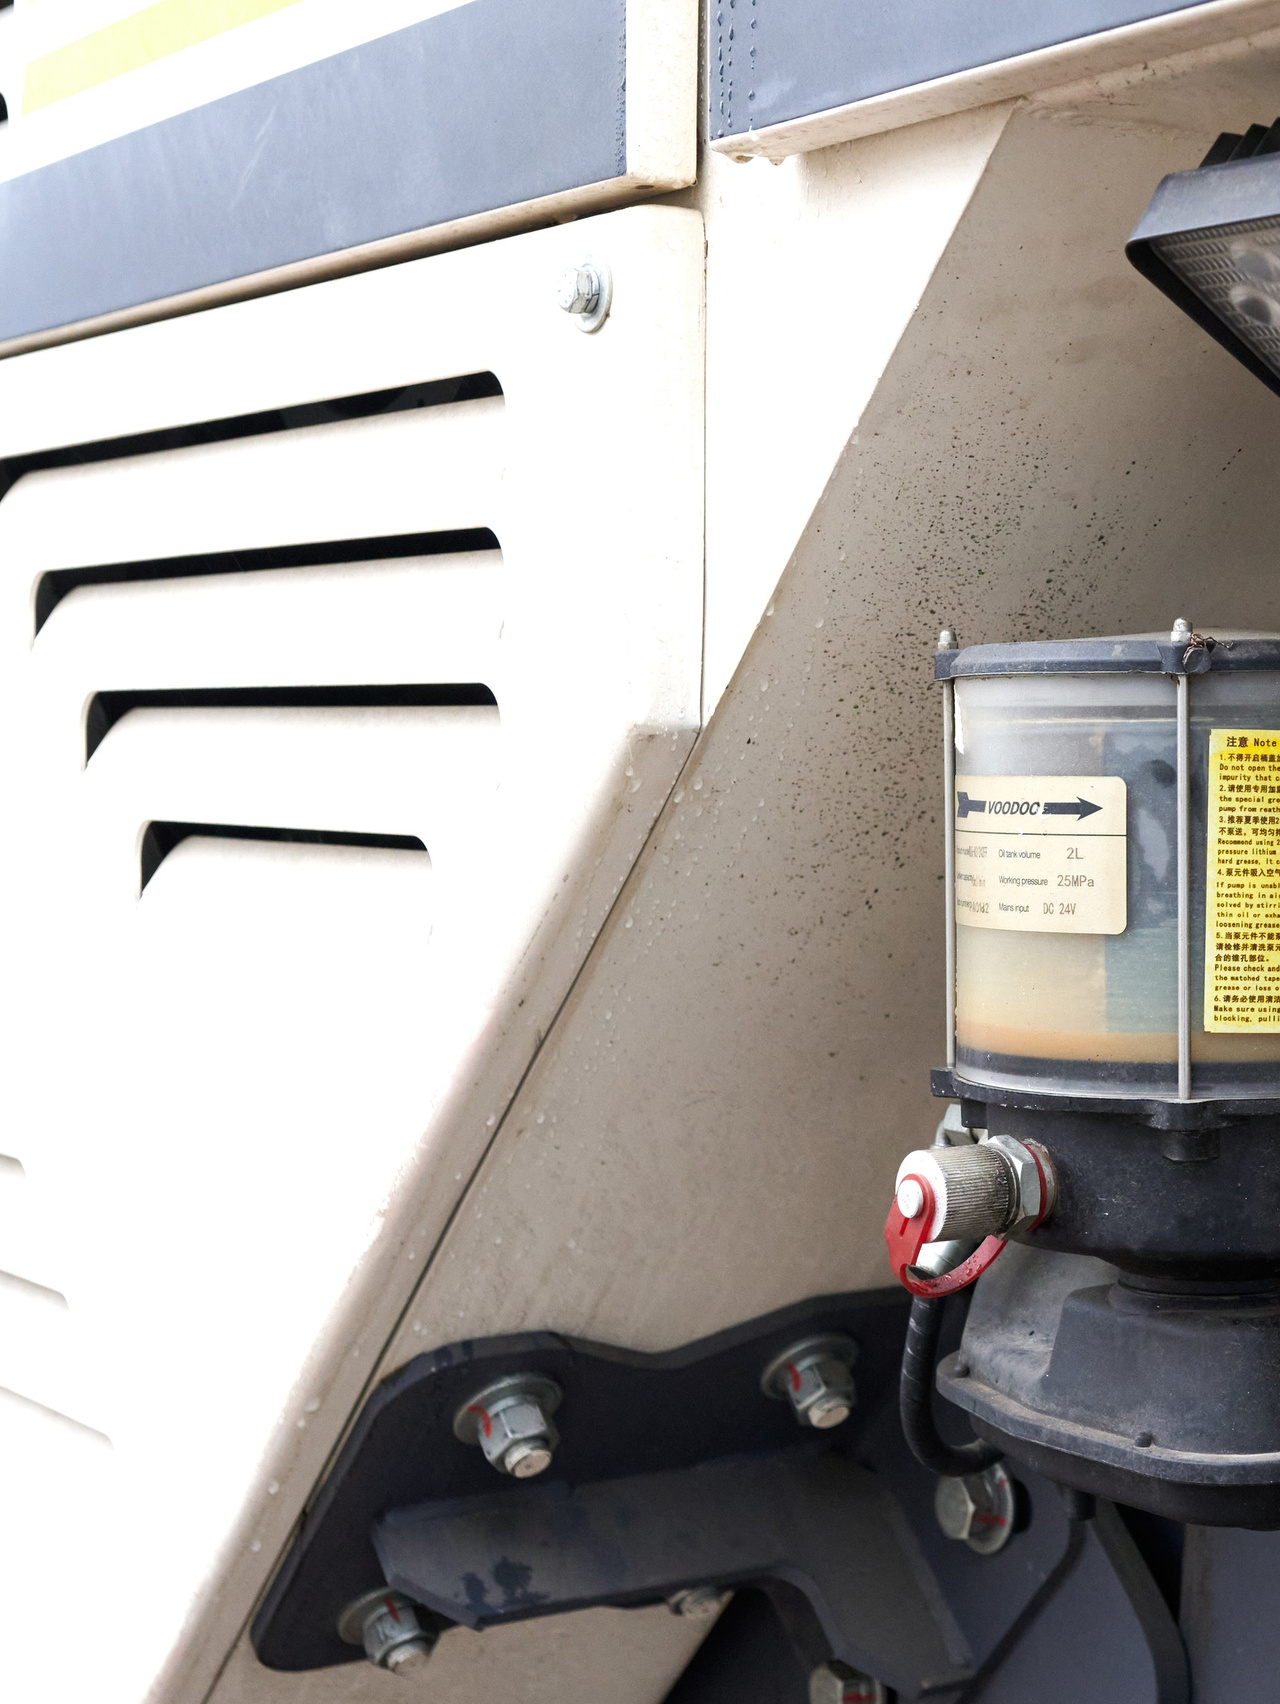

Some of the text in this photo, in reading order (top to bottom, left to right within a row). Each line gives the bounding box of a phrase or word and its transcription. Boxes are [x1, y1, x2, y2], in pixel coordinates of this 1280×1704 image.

[1226, 736, 1277, 748] 注意 Note
[1219, 774, 1251, 782] impurity
[1235, 796, 1264, 804] special
[1255, 839, 1274, 847] using
[998, 848, 1006, 859] Oil
[1005, 849, 1018, 859] tank
[1018, 851, 1041, 859] volume
[1066, 847, 1084, 860] 2L
[998, 875, 1021, 887] Working
[1021, 877, 1048, 887] pressure
[1057, 874, 1095, 887] 25MPa
[1216, 892, 1254, 900] breathing
[998, 902, 1014, 912] Mains
[1014, 903, 1030, 914] input
[1043, 902, 1054, 915] DC
[1059, 902, 1076, 915] 24V
[1245, 902, 1254, 910] by
[1216, 921, 1253, 929] loosening
